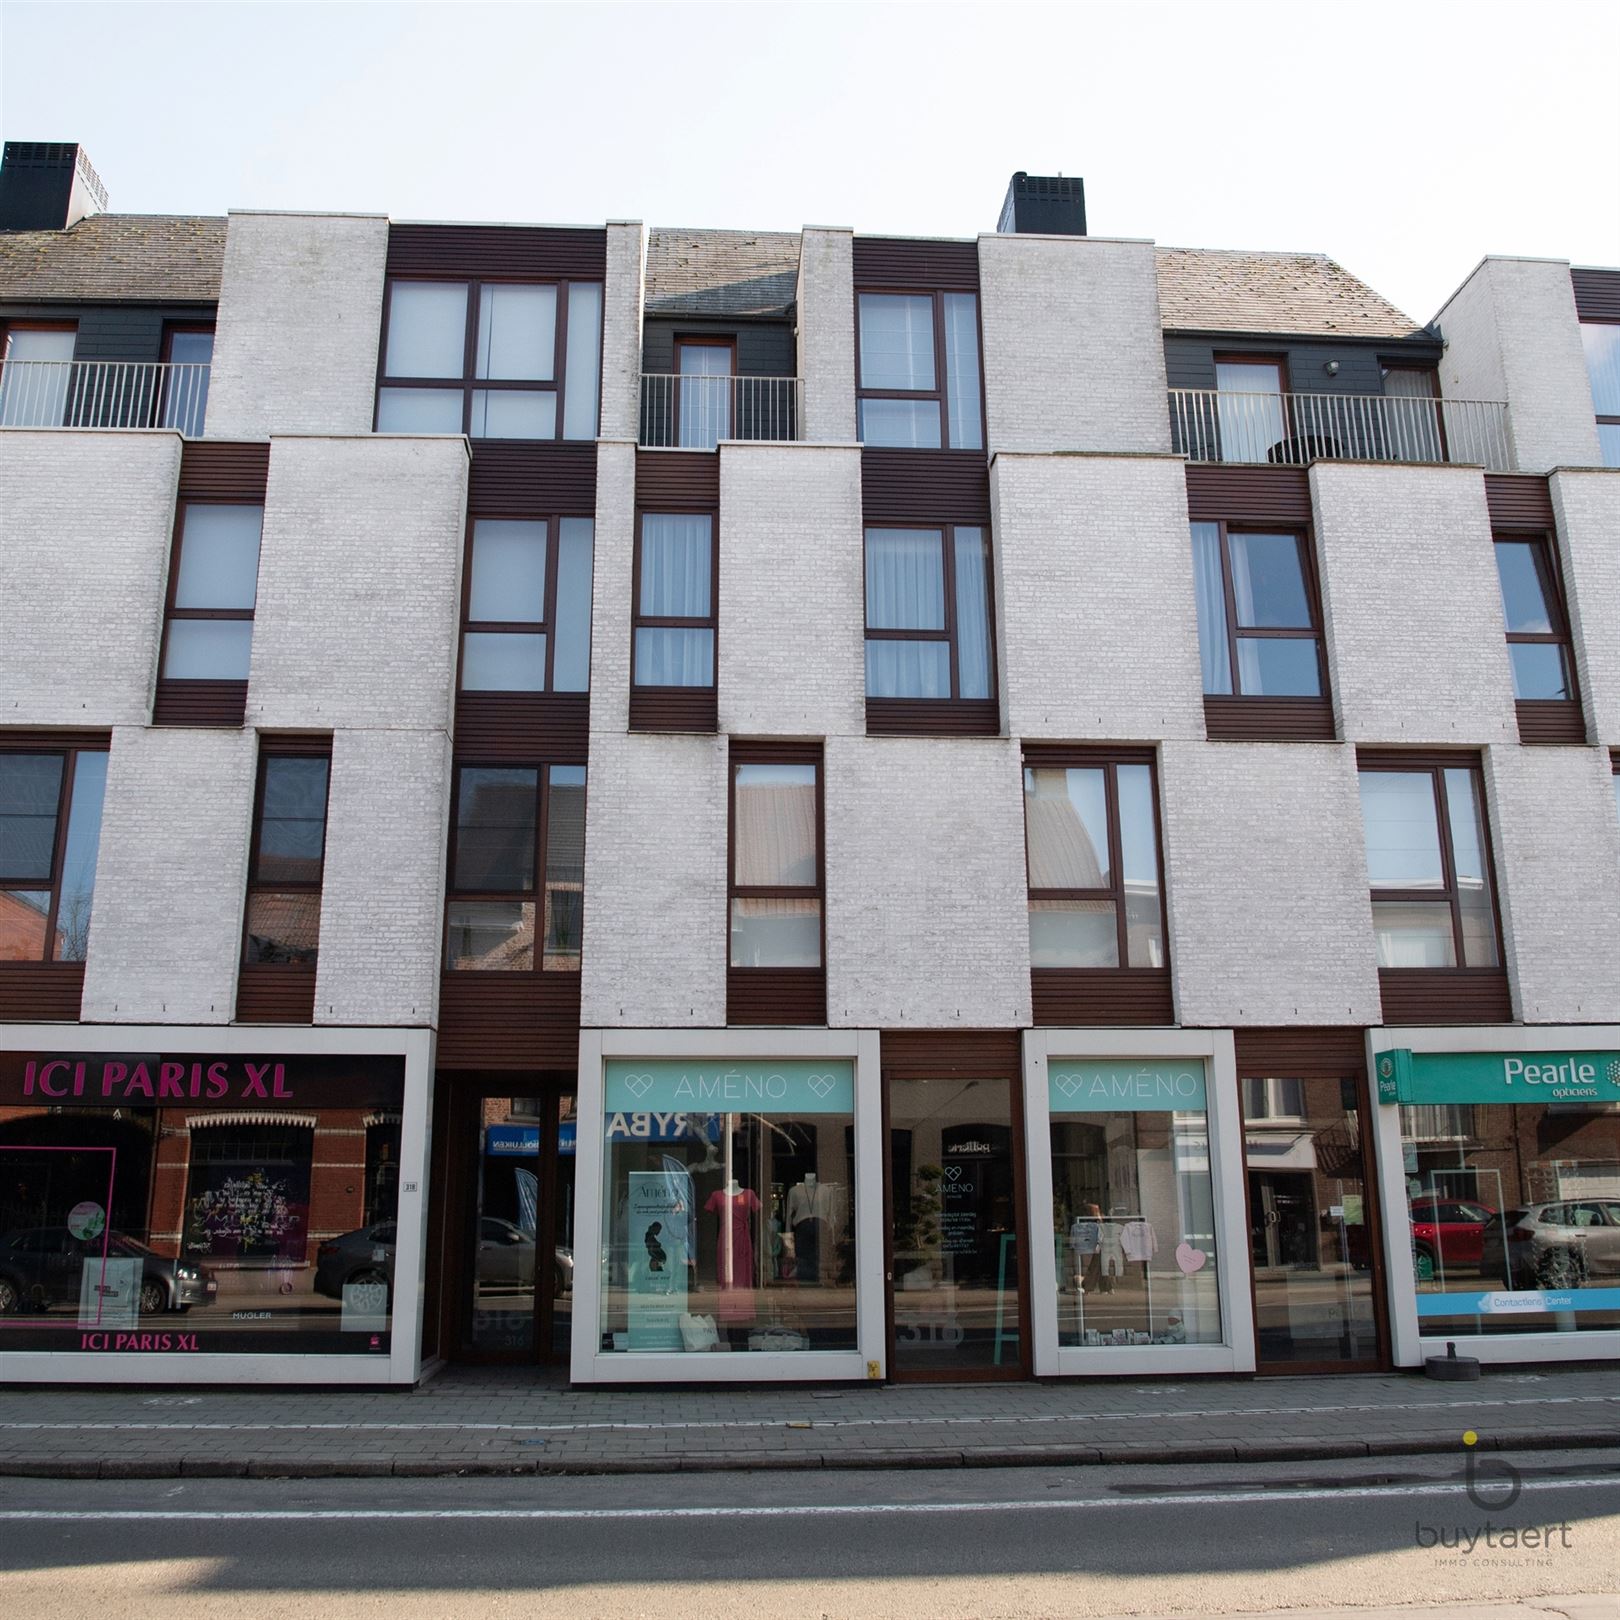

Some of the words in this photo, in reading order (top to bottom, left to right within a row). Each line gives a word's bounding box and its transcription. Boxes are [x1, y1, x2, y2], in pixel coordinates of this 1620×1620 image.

[23, 1061, 86, 1096] ICI
[102, 1061, 230, 1098] PARIS
[241, 1063, 294, 1098] XL
[1504, 1057, 1596, 1084] Pearle
[674, 1069, 787, 1098] AMÉNO
[1089, 1068, 1197, 1097] AMÉNO
[1552, 1087, 1598, 1098] opticiens
[1545, 1296, 1572, 1306] Center
[232, 1311, 272, 1320] MUGLER
[81, 1334, 110, 1350] ICI
[115, 1334, 172, 1350] PARIS
[175, 1334, 200, 1350] XL
